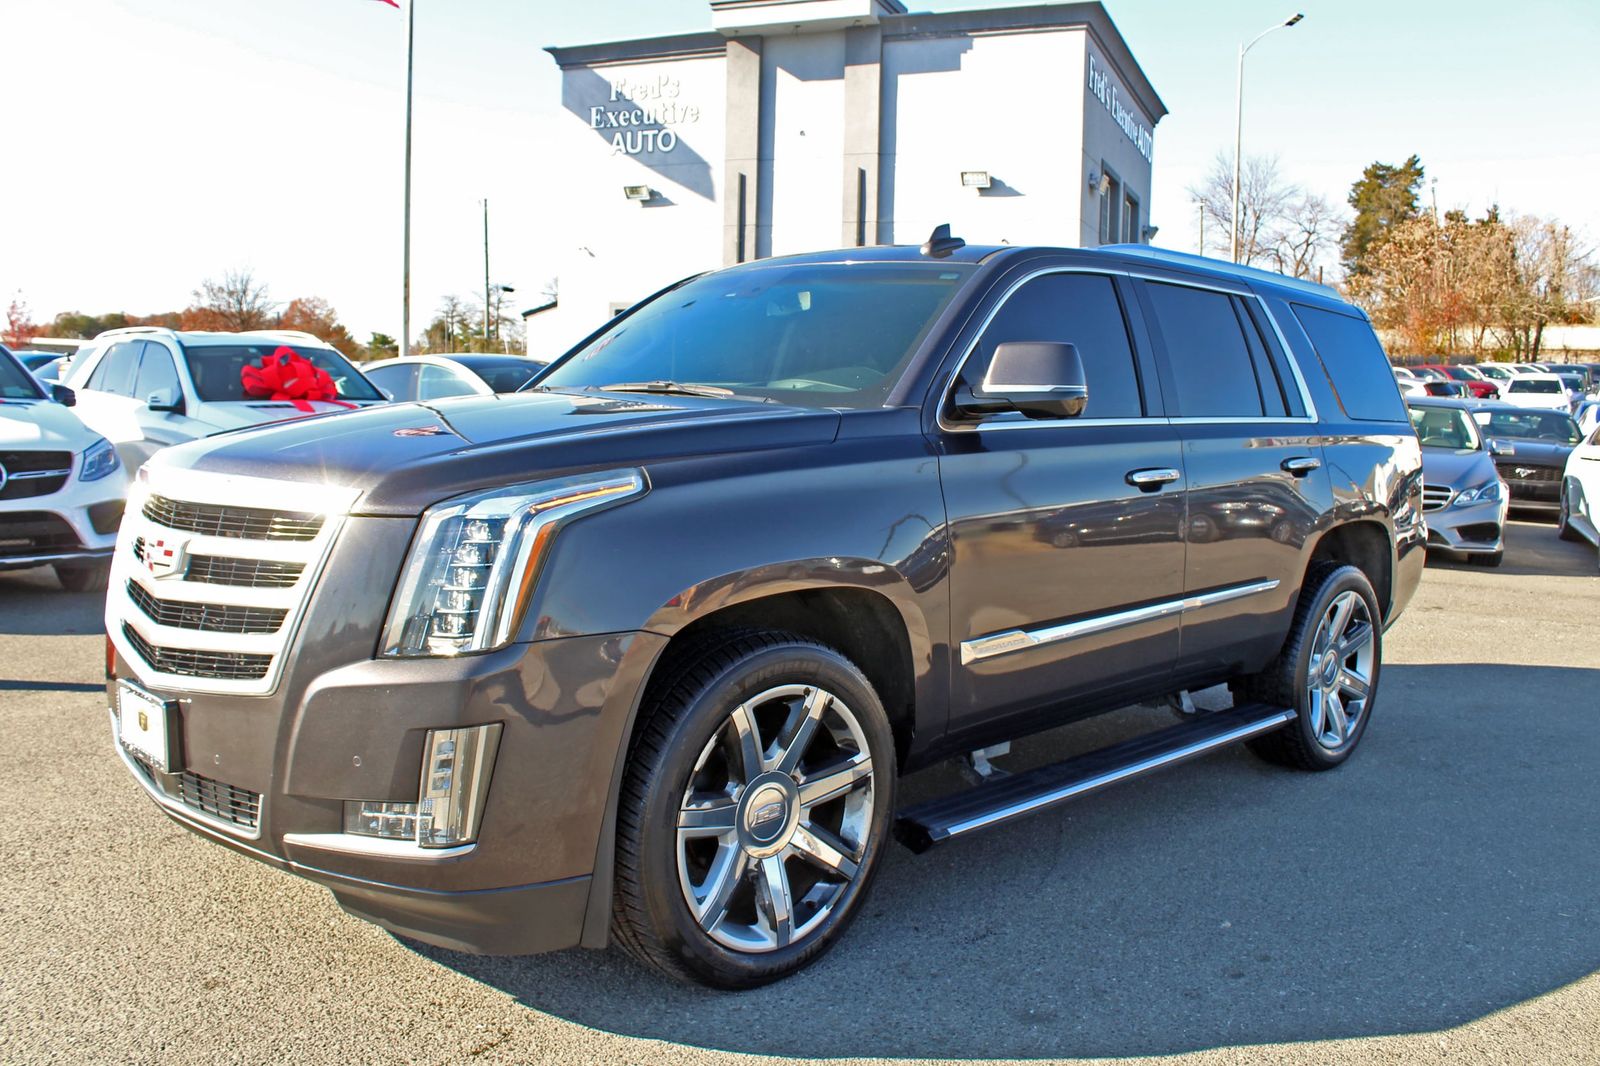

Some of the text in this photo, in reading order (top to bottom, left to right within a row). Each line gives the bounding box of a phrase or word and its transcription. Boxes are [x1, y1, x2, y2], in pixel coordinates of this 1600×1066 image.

[609, 76, 680, 101] Fred's
[590, 103, 699, 128] Executive
[1089, 55, 1153, 163] Fred's Executive AUTO
[611, 130, 676, 155] AUTO
